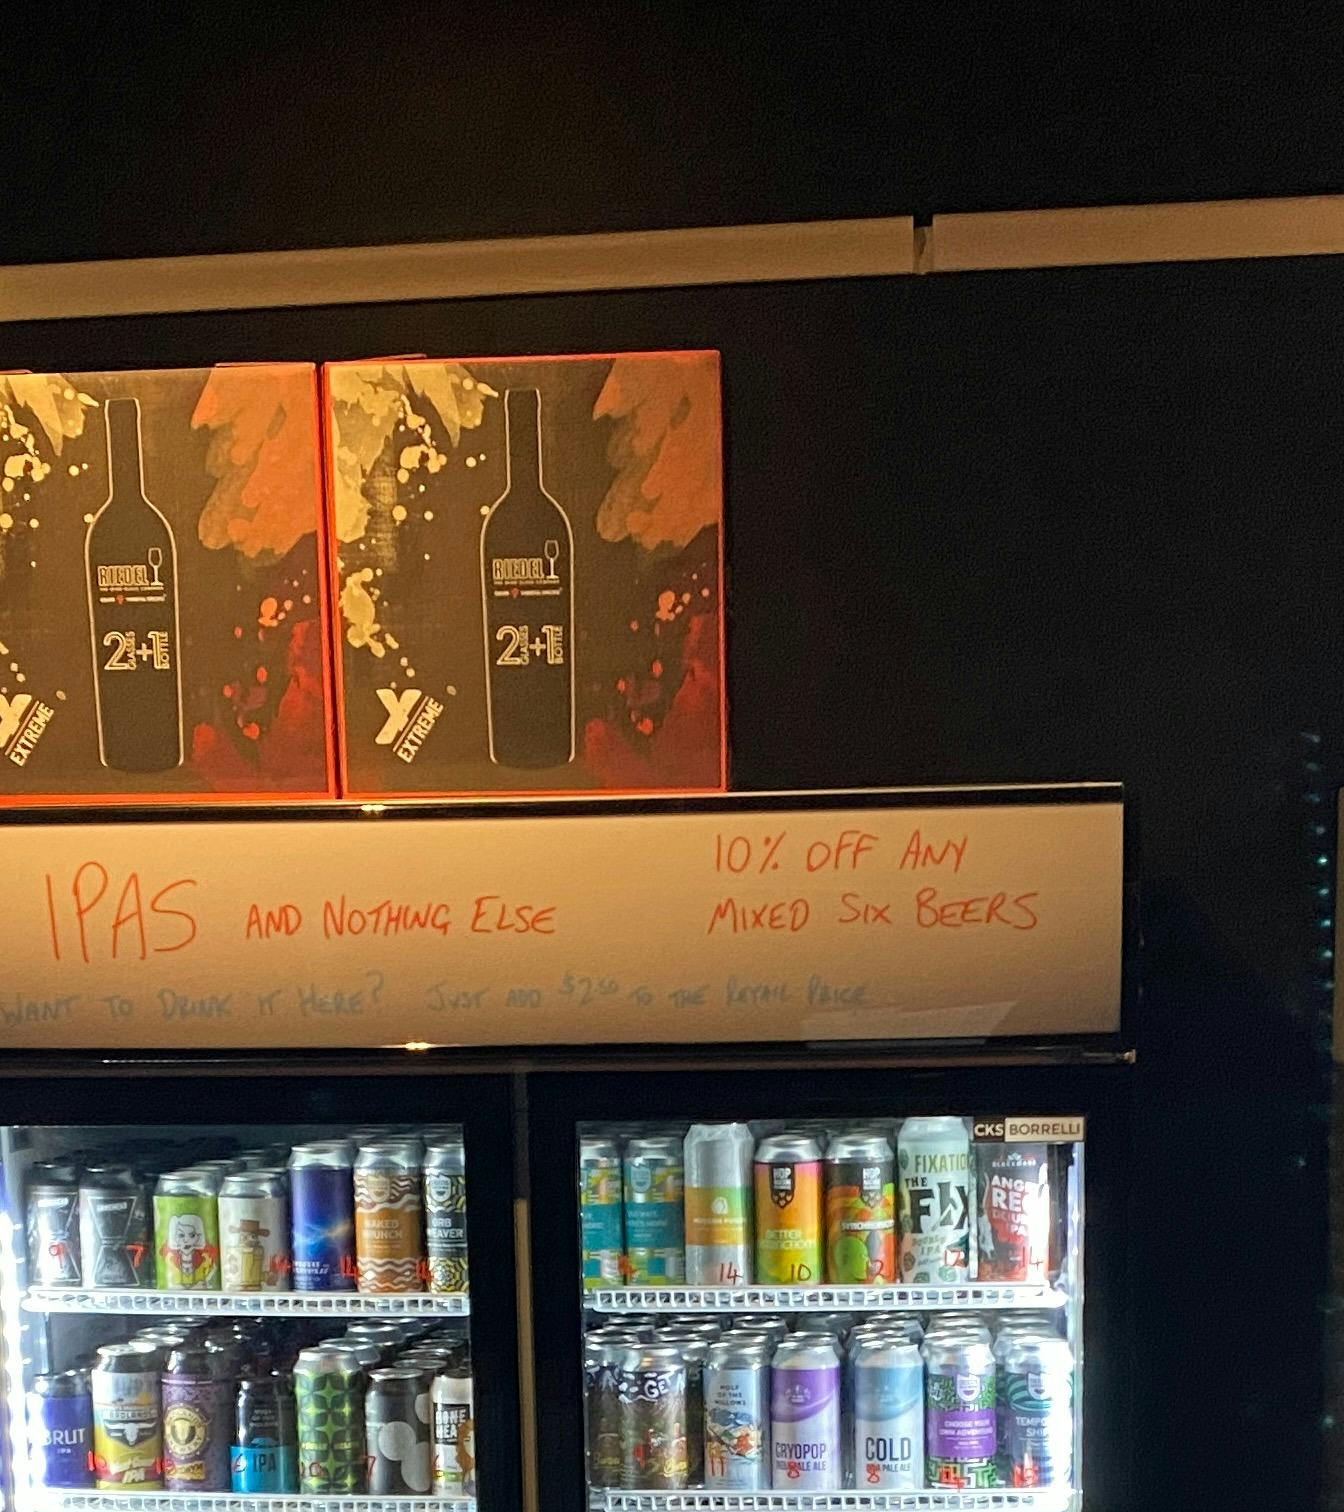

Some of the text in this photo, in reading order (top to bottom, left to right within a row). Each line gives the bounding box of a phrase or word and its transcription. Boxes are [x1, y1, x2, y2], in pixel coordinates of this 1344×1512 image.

[97, 564, 149, 587] RIEDEL
[492, 557, 545, 580] RIEDEL
[9, 702, 55, 767] EXTREME
[396, 697, 444, 763] EXTREME
[716, 829, 968, 874] 10% OFF ANY
[45, 861, 556, 964] IPAS AND NOTHING ELSE
[708, 887, 1040, 936] MIXED SIX BEERS
[103, 994, 132, 1017] TO
[258, 989, 280, 1015] IT
[974, 1124, 1081, 1138] CKS BORRELLI
[914, 1154, 973, 1174] FIXATIO
[904, 1176, 928, 1188] THE
[124, 1243, 145, 1269] 7
[719, 1261, 744, 1284] 14
[790, 1262, 812, 1282] 10
[42, 1427, 87, 1447] BRUT
[775, 1442, 827, 1460] CRYOPOP
[865, 1437, 911, 1461] COLD
[251, 1452, 277, 1473] IPA
